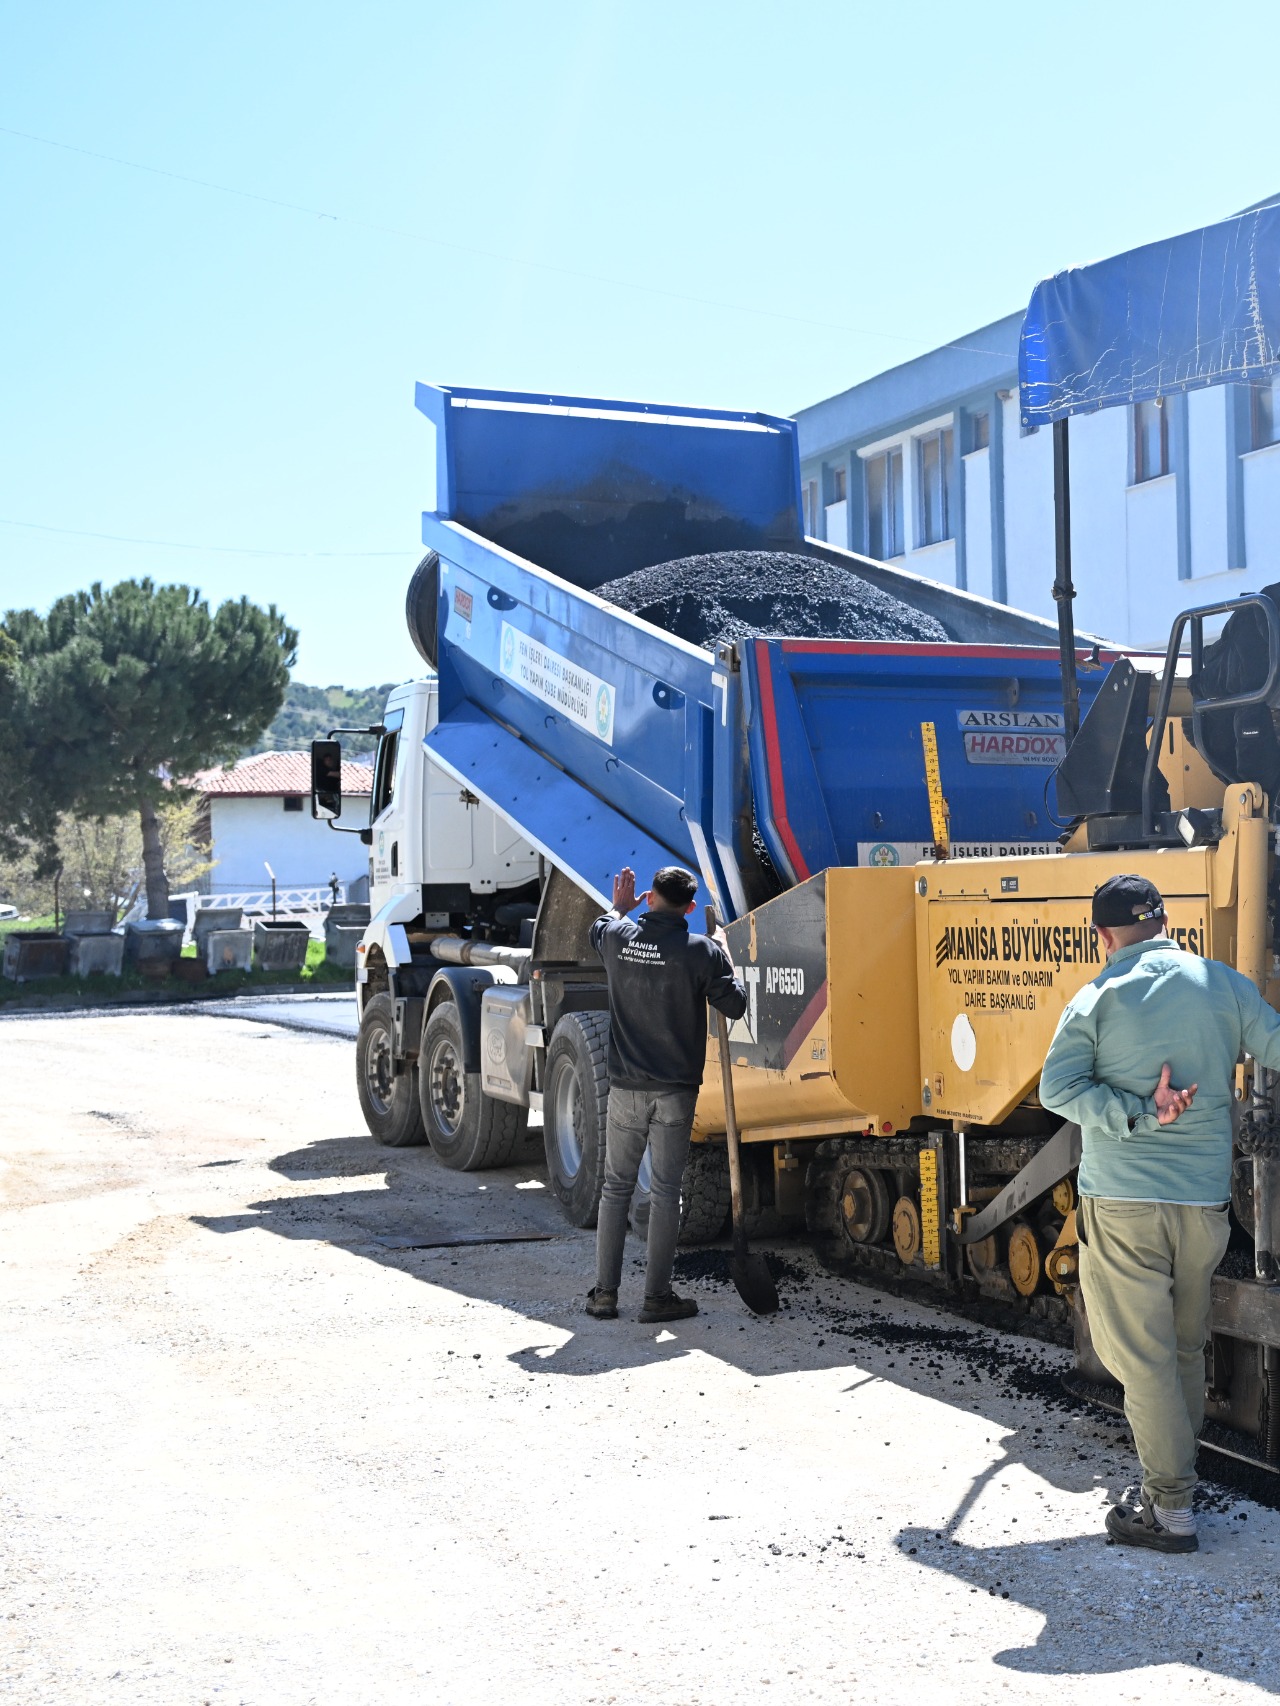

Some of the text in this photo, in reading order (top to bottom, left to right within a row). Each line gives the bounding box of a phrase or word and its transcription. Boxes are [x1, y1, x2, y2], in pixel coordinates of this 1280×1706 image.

[519, 641, 528, 655] FEN
[520, 664, 529, 681] YOL
[529, 670, 544, 689] YAPIM
[964, 712, 1060, 728] ARSLAN
[970, 735, 1058, 754] HARDOX
[953, 844, 993, 858] İŞLERİ
[1000, 844, 1050, 857] DAİRESİ
[622, 947, 661, 959] BÜYÜKŞEHİR
[628, 940, 658, 951] MANİSA
[944, 917, 1101, 973] MANİSA BÜYÜKŞEHİR
[765, 966, 805, 996] AP655D
[948, 968, 1053, 987] YOL YAPIM BAKIM ve ONARIM
[964, 988, 1036, 1012] DAİRE BAŞKANLIĞI
